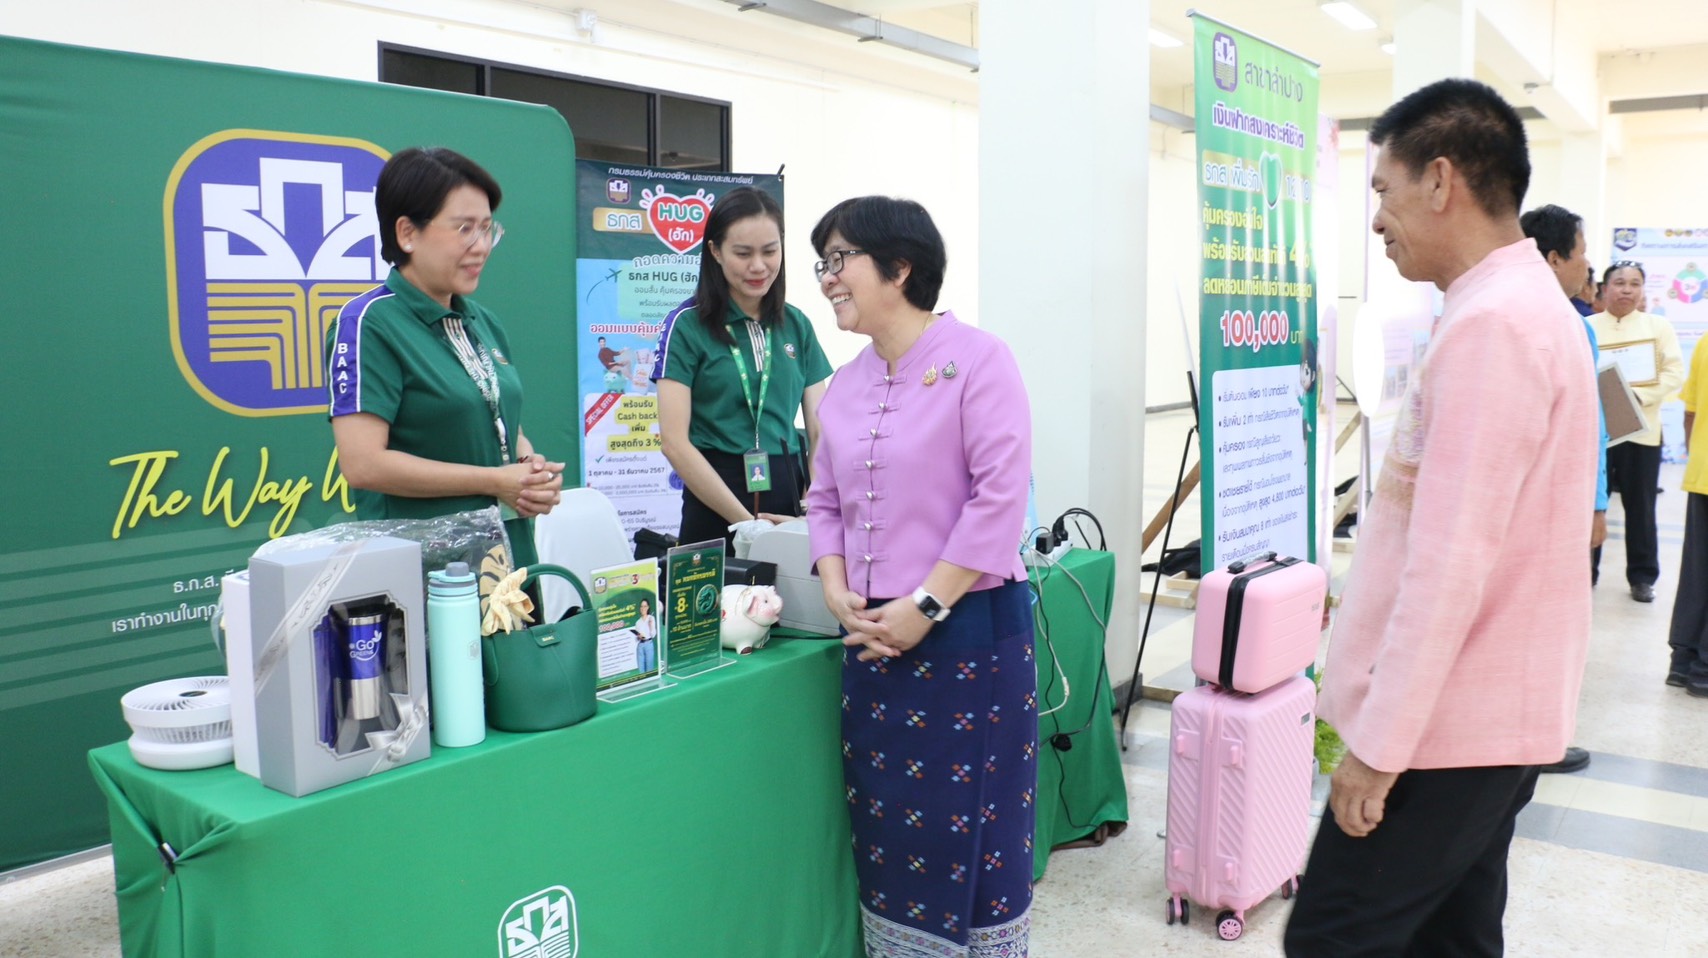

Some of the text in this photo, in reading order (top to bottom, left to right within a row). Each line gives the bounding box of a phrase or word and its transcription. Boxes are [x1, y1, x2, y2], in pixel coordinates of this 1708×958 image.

[1245, 61, 1304, 102] สาขาลำปาง
[1213, 102, 1305, 149] เงินฝากสงเคราะห์ชีวิต
[659, 203, 705, 222] HUG
[607, 213, 643, 231] ธกส
[668, 227, 694, 242] (ฮัก)
[629, 271, 699, 284] ธกส HUG (ฮัก
[1220, 310, 1289, 353] 100,000
[337, 343, 348, 394] BAAC
[623, 400, 653, 408] พร้อมรับ
[639, 412, 658, 420] back
[631, 422, 646, 432] เพิ่ม
[610, 439, 644, 451] สูงสุดถึง
[645, 439, 652, 447] 3
[109, 450, 192, 539] The
[202, 446, 313, 539] Way
[173, 575, 219, 593] ธ.ก.ส.
[677, 597, 686, 613] 8
[356, 639, 375, 651] Go
